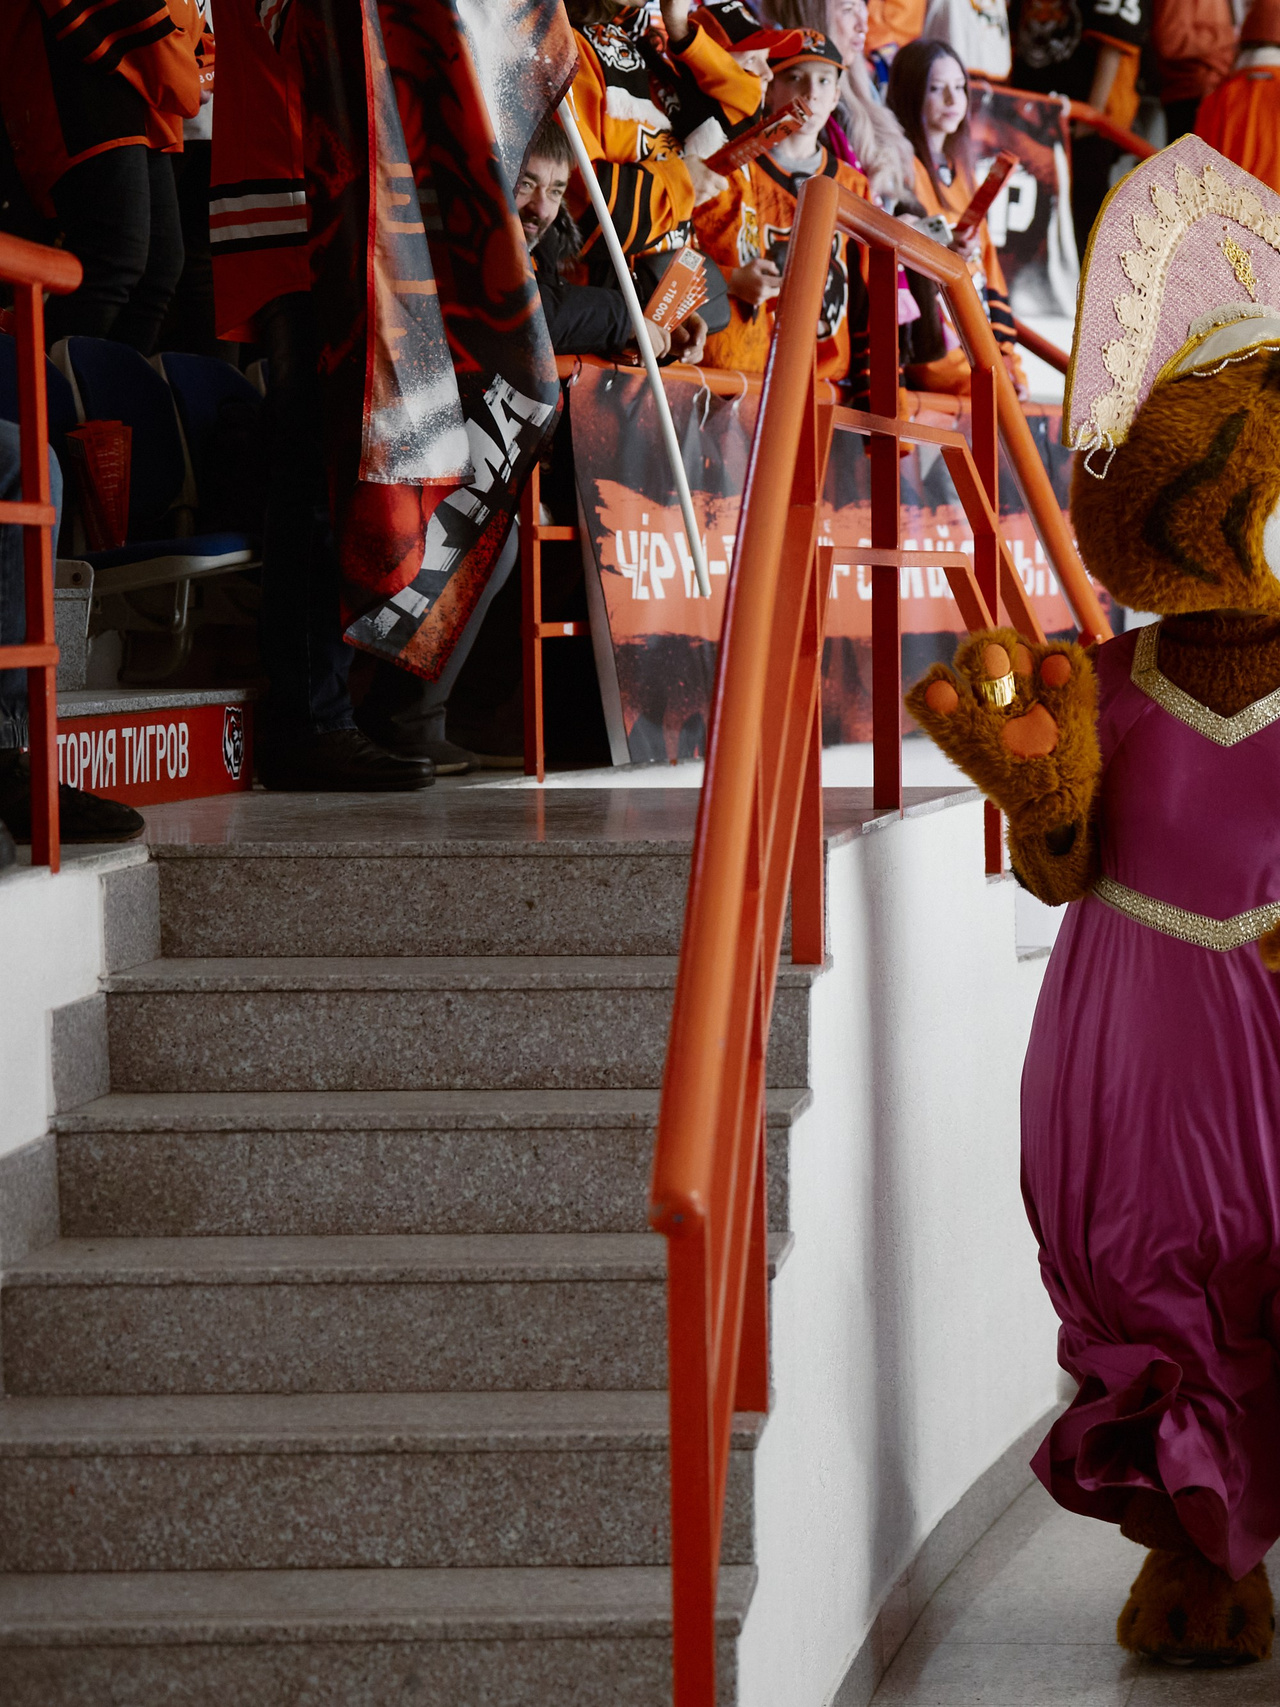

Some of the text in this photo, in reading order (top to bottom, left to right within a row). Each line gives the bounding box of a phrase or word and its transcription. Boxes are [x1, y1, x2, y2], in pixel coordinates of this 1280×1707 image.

[663, 288, 677, 303] 118
[652, 303, 668, 321] 000
[121, 722, 189, 786] ТИГРОВ
